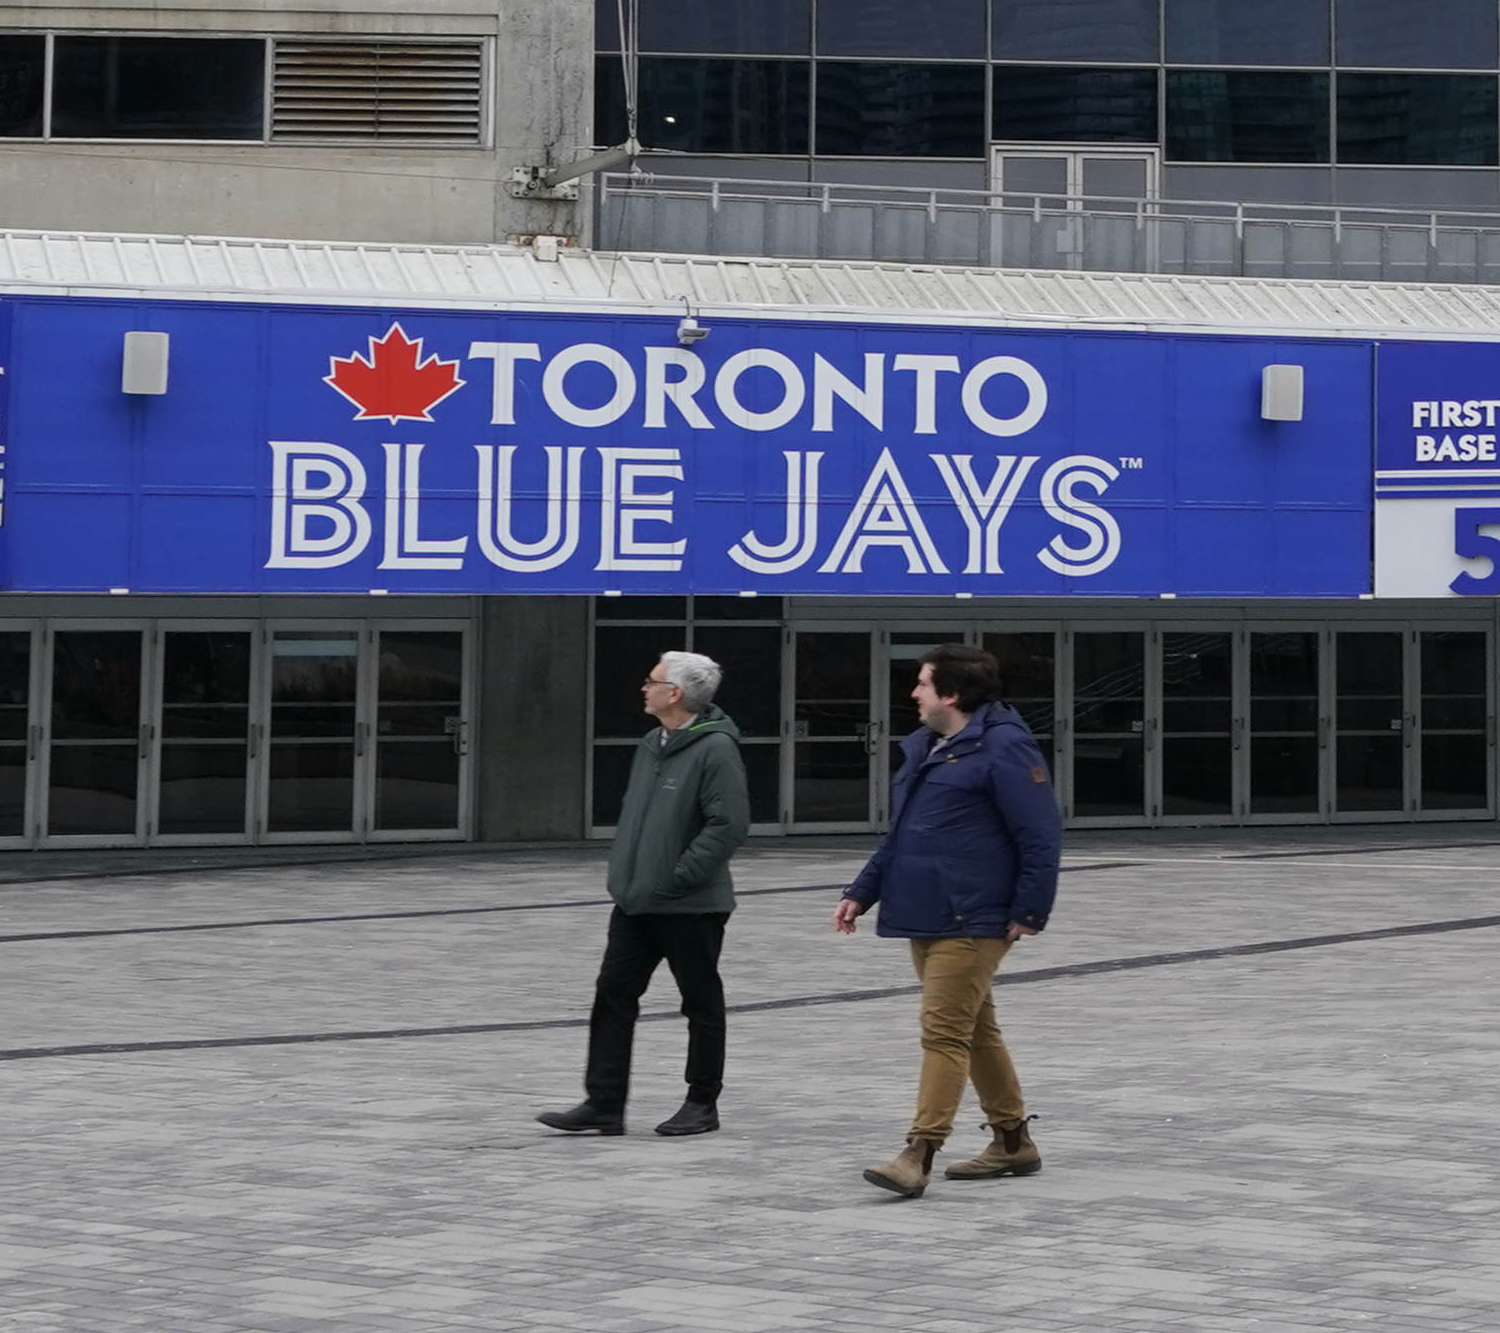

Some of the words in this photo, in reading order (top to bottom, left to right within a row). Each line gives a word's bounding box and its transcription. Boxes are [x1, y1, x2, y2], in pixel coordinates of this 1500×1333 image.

[467, 340, 1049, 437] TORONTO
[1416, 434, 1497, 462] BASE
[265, 441, 688, 574] BLUE
[728, 446, 1122, 576] JAYS
